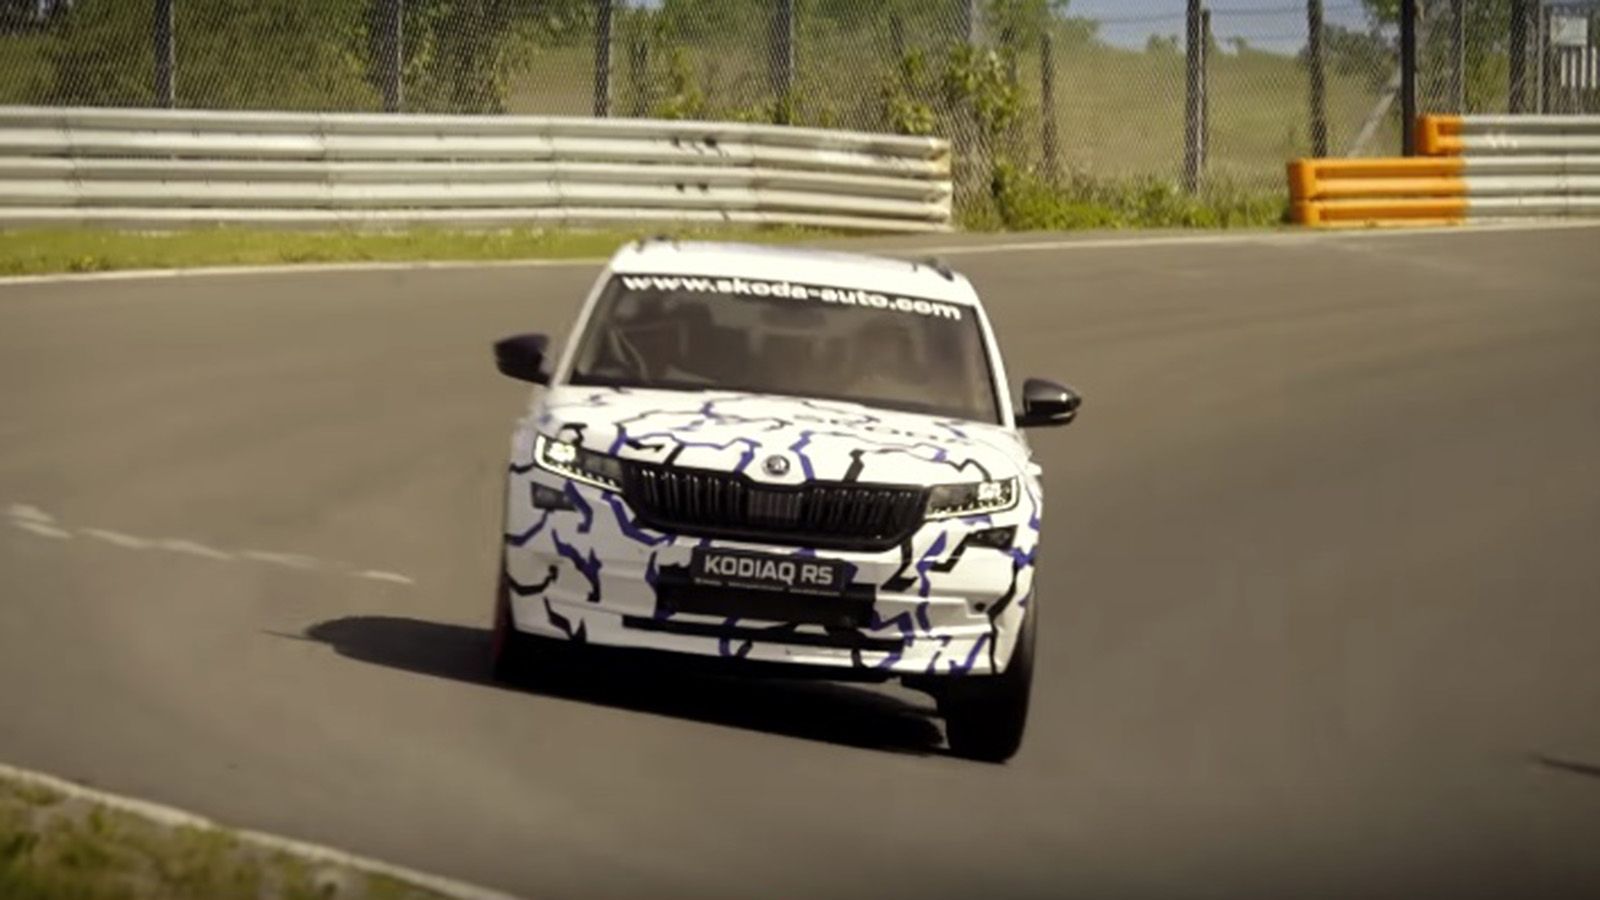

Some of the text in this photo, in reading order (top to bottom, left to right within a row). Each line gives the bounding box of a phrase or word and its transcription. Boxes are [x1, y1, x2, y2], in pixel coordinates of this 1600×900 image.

[622, 275, 962, 320] www.skoda-auto.com
[704, 555, 834, 585] KODIAQ RS
